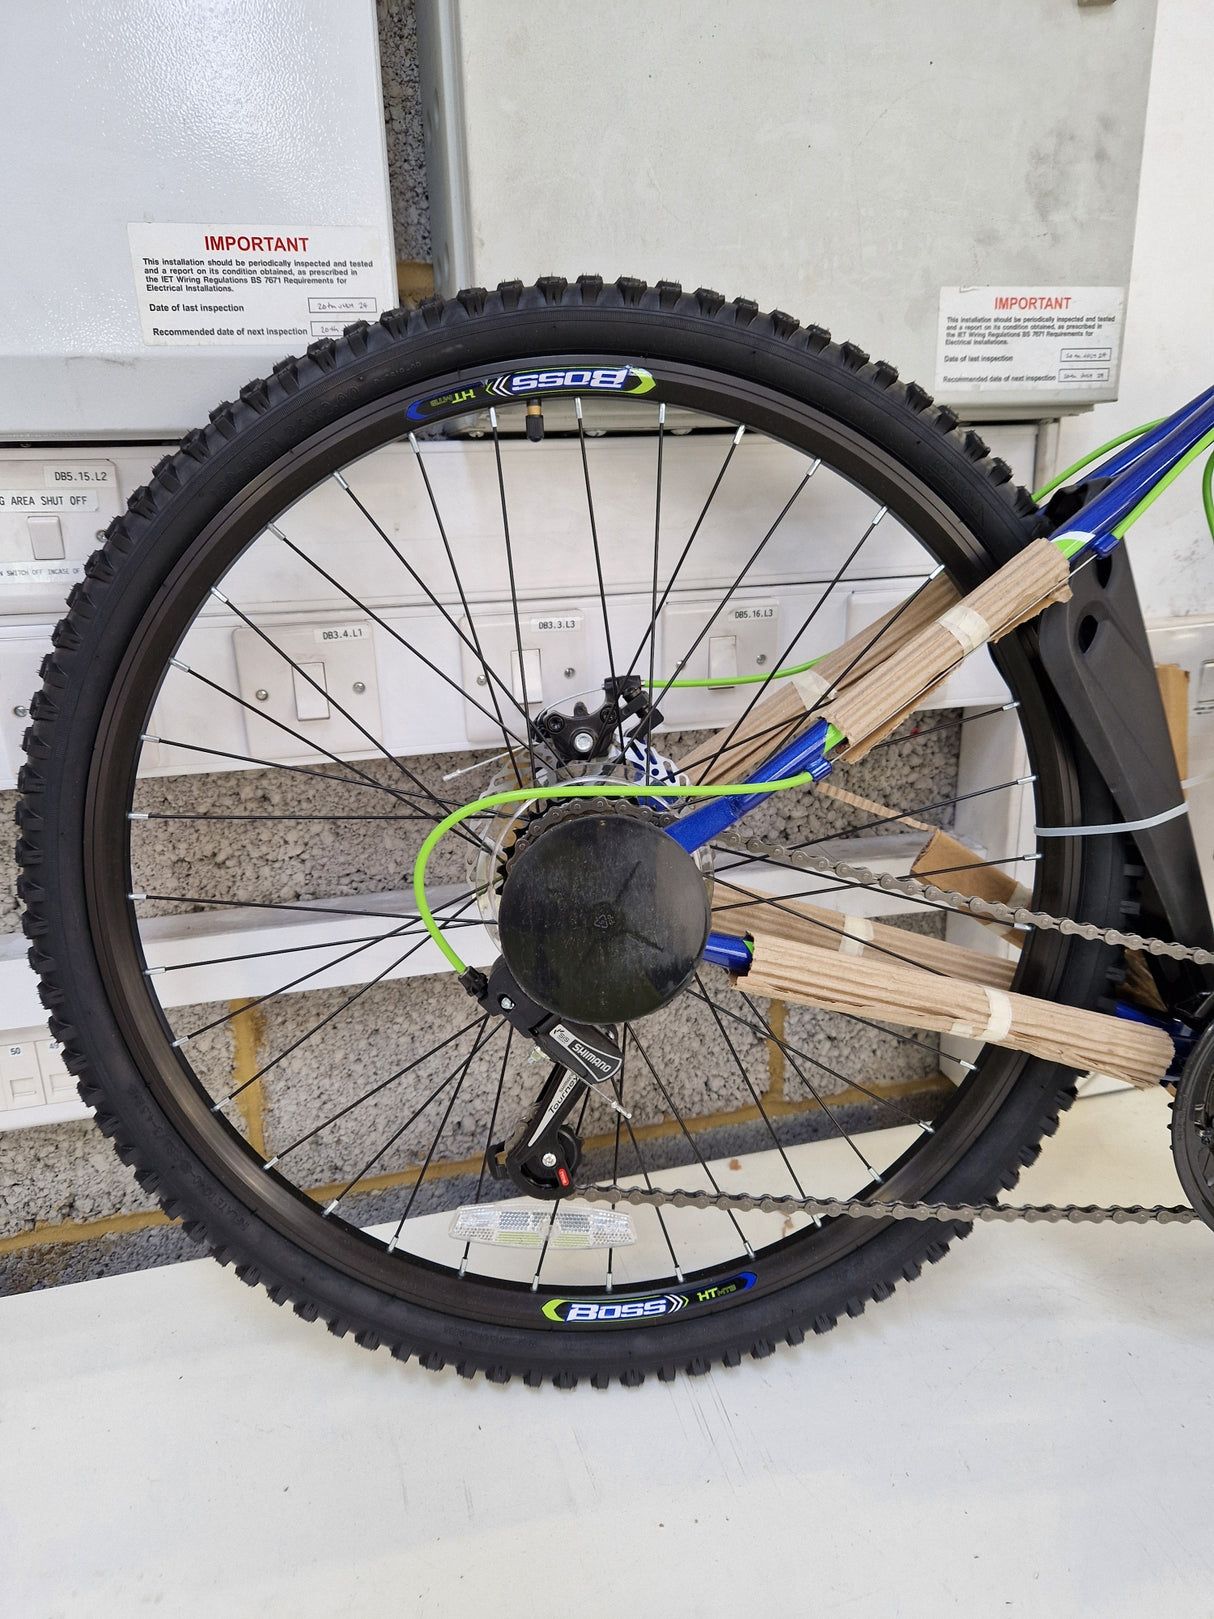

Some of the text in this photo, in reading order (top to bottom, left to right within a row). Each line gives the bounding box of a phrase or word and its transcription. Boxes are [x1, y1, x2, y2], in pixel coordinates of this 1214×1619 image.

[204, 236, 309, 252] IMPORTANT
[162, 258, 205, 266] installation
[249, 260, 291, 268] periodically
[294, 260, 330, 268] inspected
[176, 276, 200, 284] Wiring
[204, 276, 248, 284] Regulations
[284, 277, 334, 285] Requirements
[994, 297, 1072, 310] IMPORTANT
[200, 304, 244, 313] inspection
[153, 328, 215, 336] Recommended
[216, 328, 234, 336] date
[237, 328, 245, 336] of
[266, 328, 308, 336] inspection
[981, 355, 1013, 363] inspection
[512, 369, 628, 391] BOSS
[452, 389, 476, 404] HT
[55, 472, 107, 481] DB5.15.L2
[11, 496, 35, 505] AREA
[41, 496, 63, 505] SHUT
[70, 496, 87, 505] OFF
[735, 609, 773, 618] DB5.16.L3
[539, 620, 575, 629] DB3.3.L3
[323, 628, 362, 640] DB3.4.L1
[10, 1047, 21, 1055] 50
[572, 1043, 611, 1072] SHIMANO
[548, 1074, 578, 1114] Tourney
[566, 1300, 666, 1321] BOSS
[696, 1287, 718, 1301] HT
